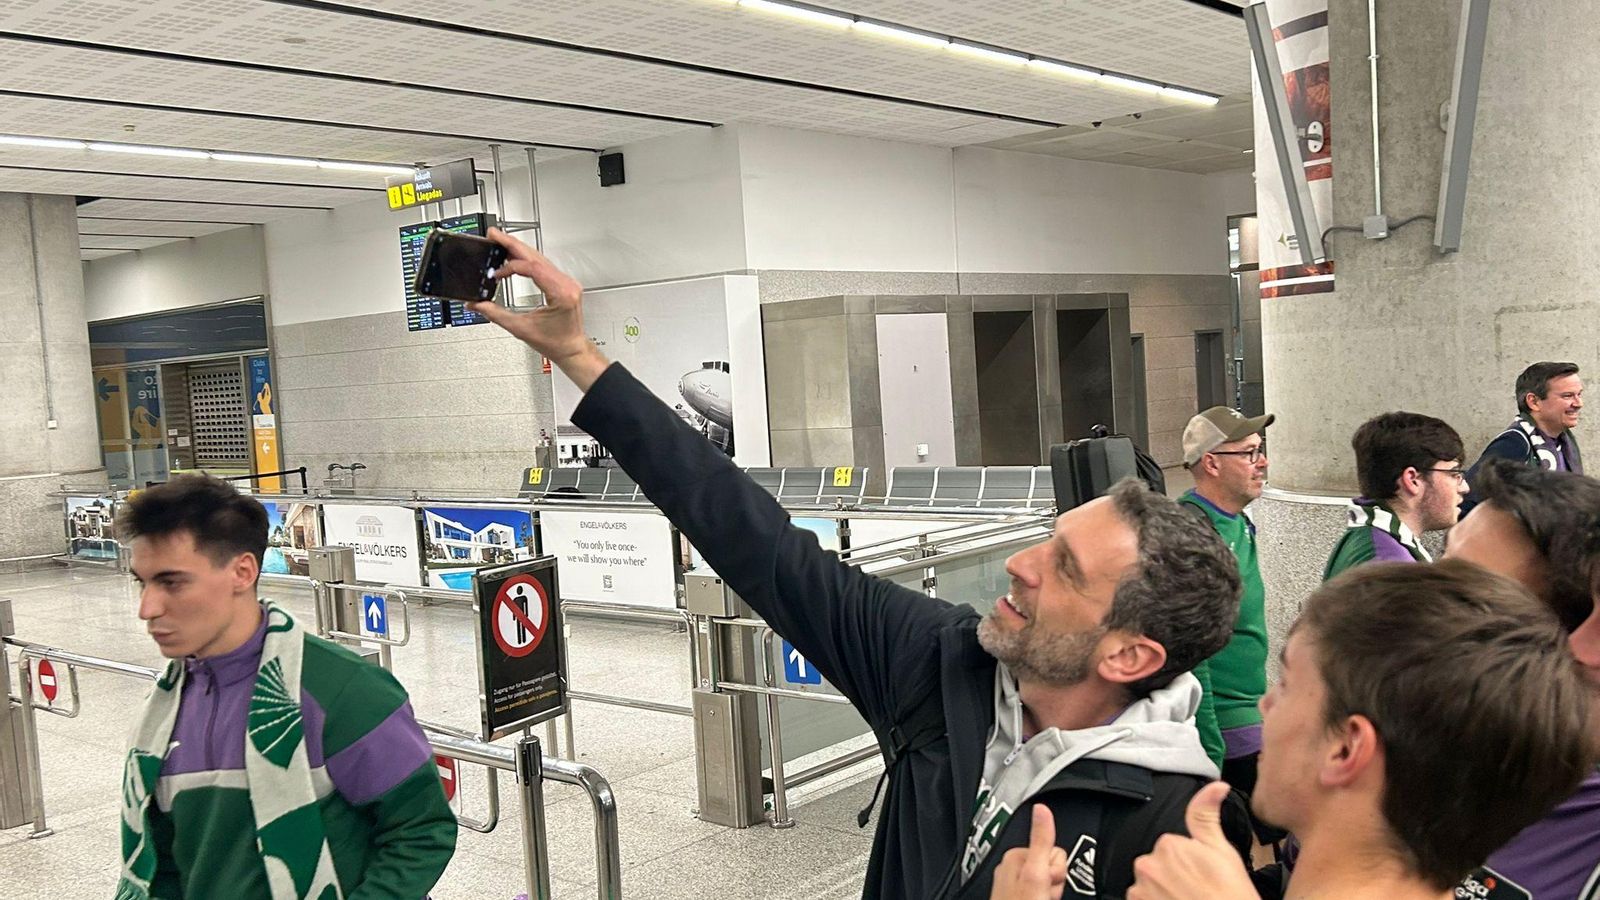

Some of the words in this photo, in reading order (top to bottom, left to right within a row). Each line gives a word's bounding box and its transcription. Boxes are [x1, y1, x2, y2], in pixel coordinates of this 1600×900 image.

[417, 189, 442, 201] Llegadas
[590, 541, 604, 552] only
[605, 541, 617, 551] live
[578, 554, 589, 563] will
[590, 555, 608, 564] show
[609, 558, 621, 567] you
[1461, 874, 1489, 896] iga
